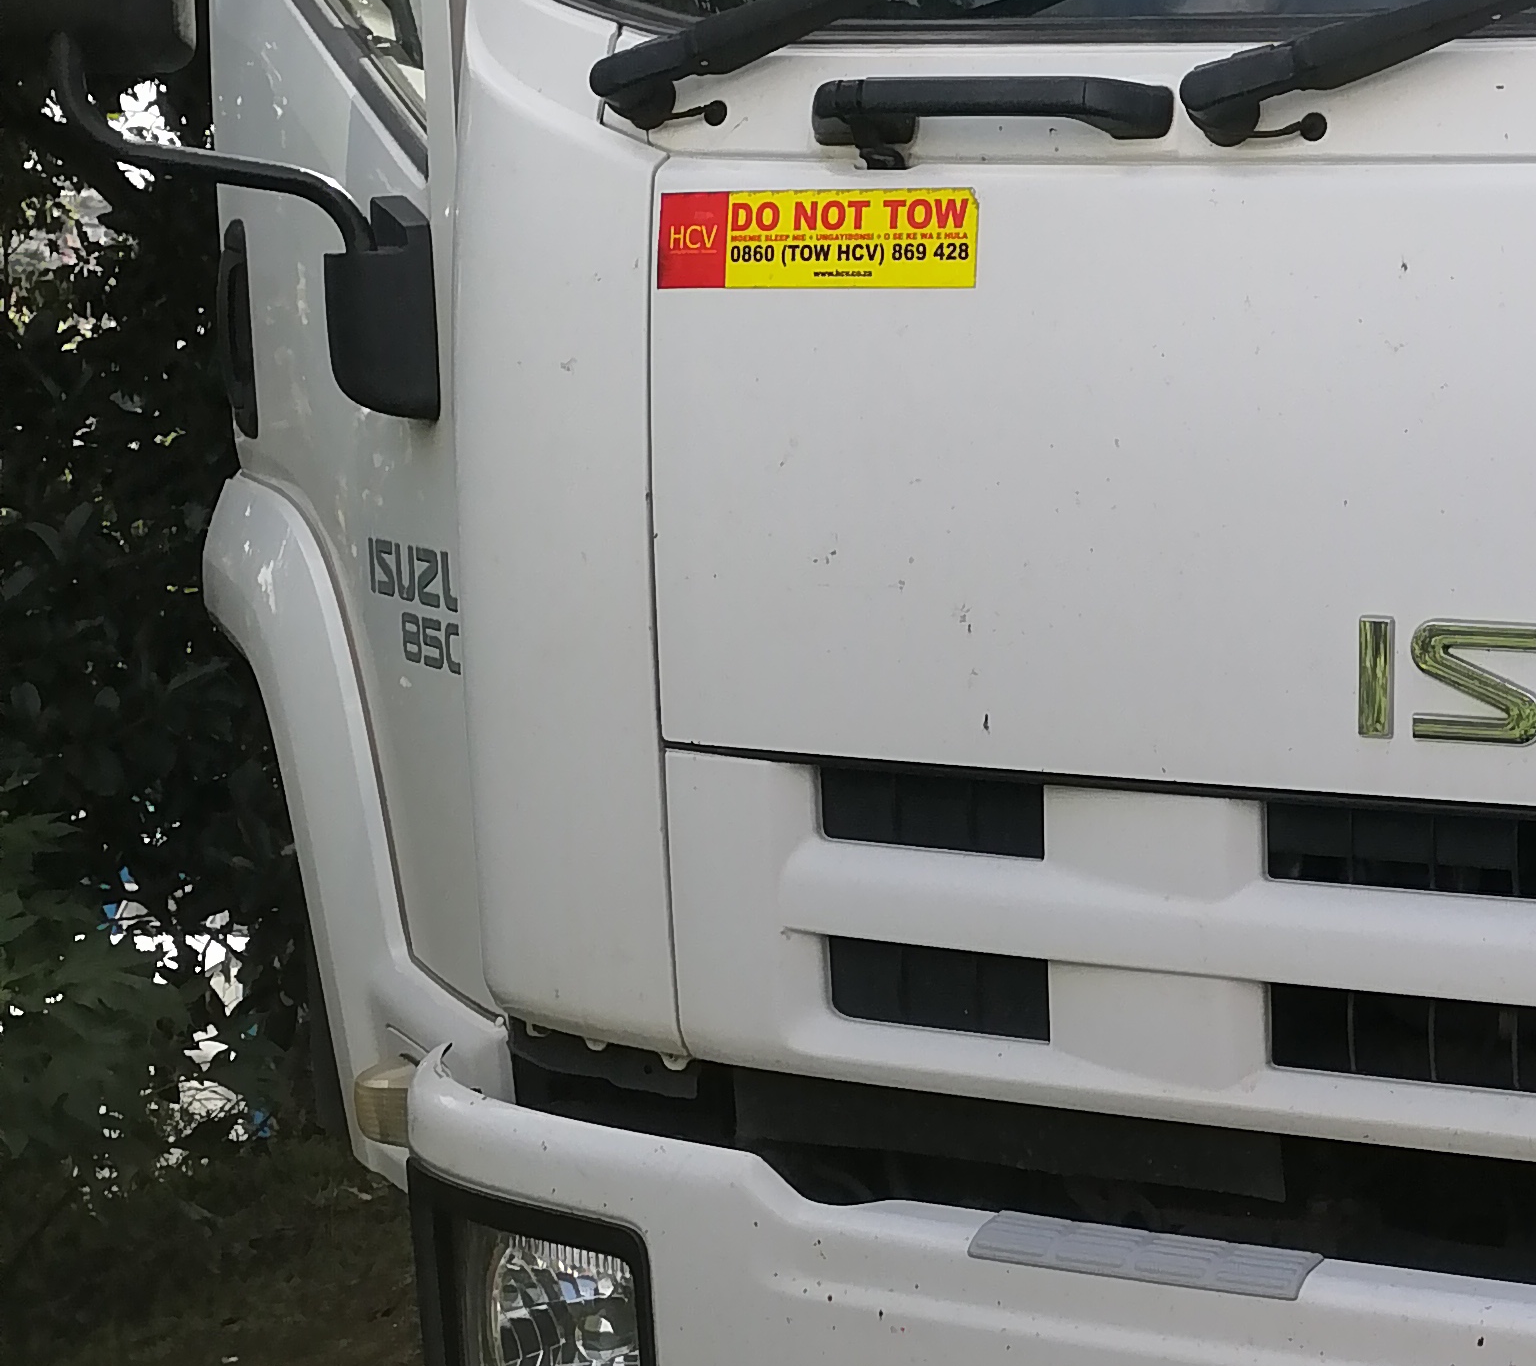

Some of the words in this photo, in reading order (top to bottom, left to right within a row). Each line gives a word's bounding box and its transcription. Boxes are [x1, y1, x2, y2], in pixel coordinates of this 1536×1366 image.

[731, 202, 780, 232] DO
[793, 200, 871, 231] NOT
[883, 198, 969, 229] TOW
[670, 224, 718, 249] HCV
[731, 245, 775, 262] 0860
[781, 244, 831, 267] (TOW
[837, 243, 885, 266] HCV)
[892, 243, 926, 261] 869
[933, 242, 969, 261] 428
